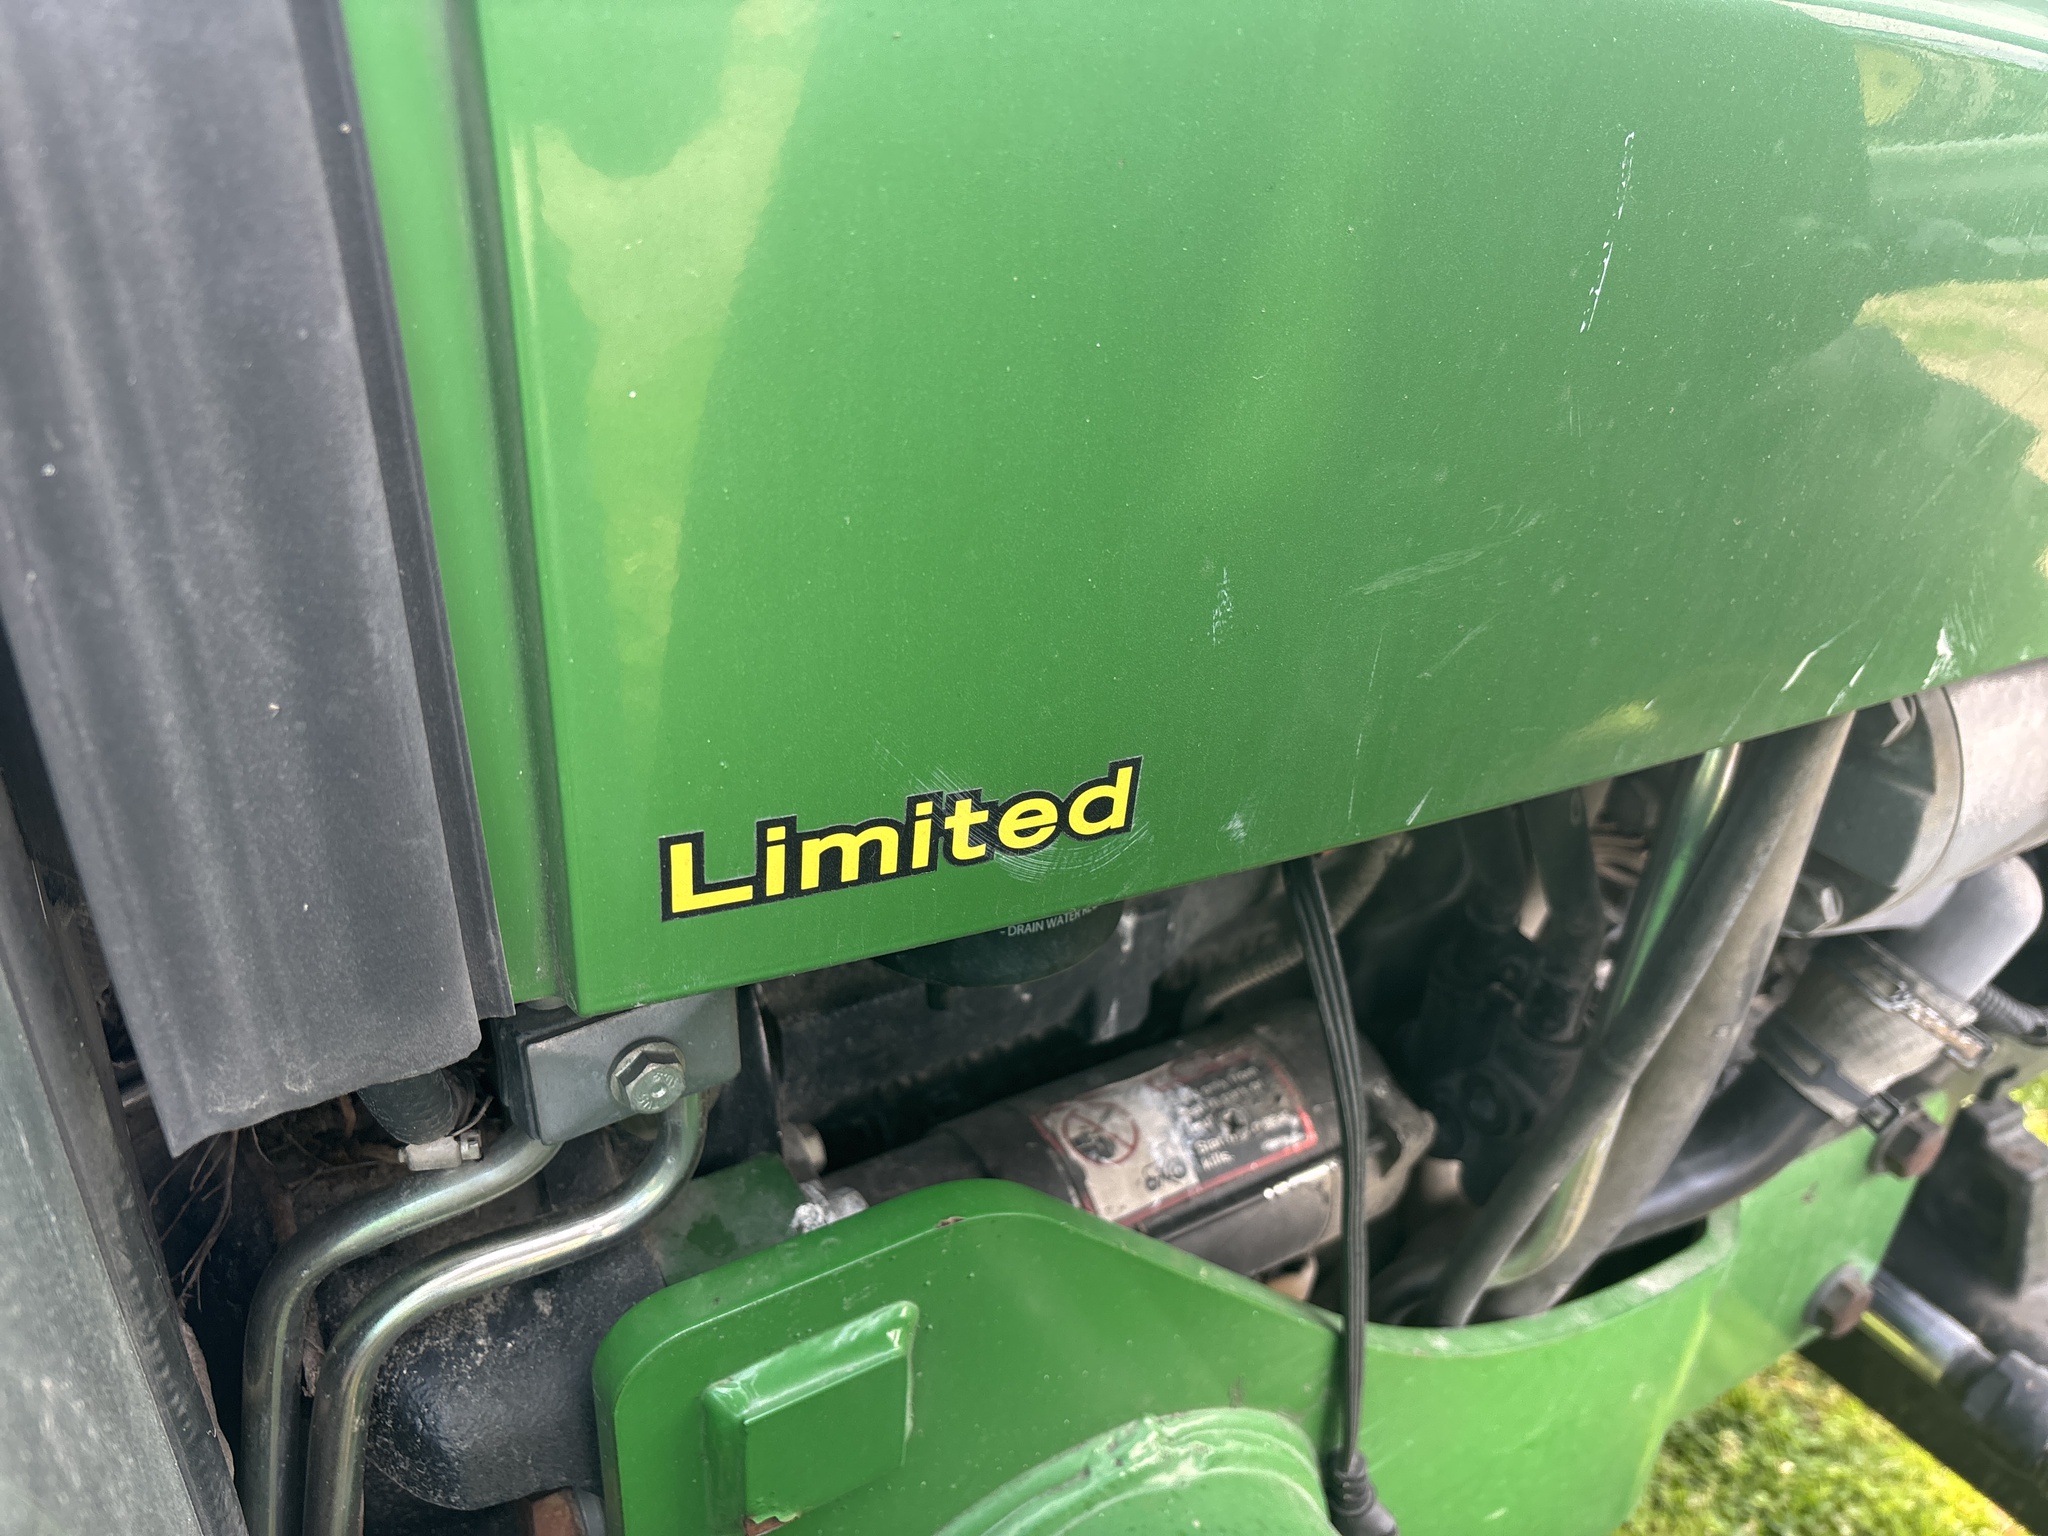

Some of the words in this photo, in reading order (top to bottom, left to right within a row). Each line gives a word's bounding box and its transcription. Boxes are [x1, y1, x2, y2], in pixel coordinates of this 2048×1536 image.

[667, 762, 1137, 916] Limited
[1007, 922, 1045, 937] DRAIN
[1046, 909, 1081, 929] WATER
